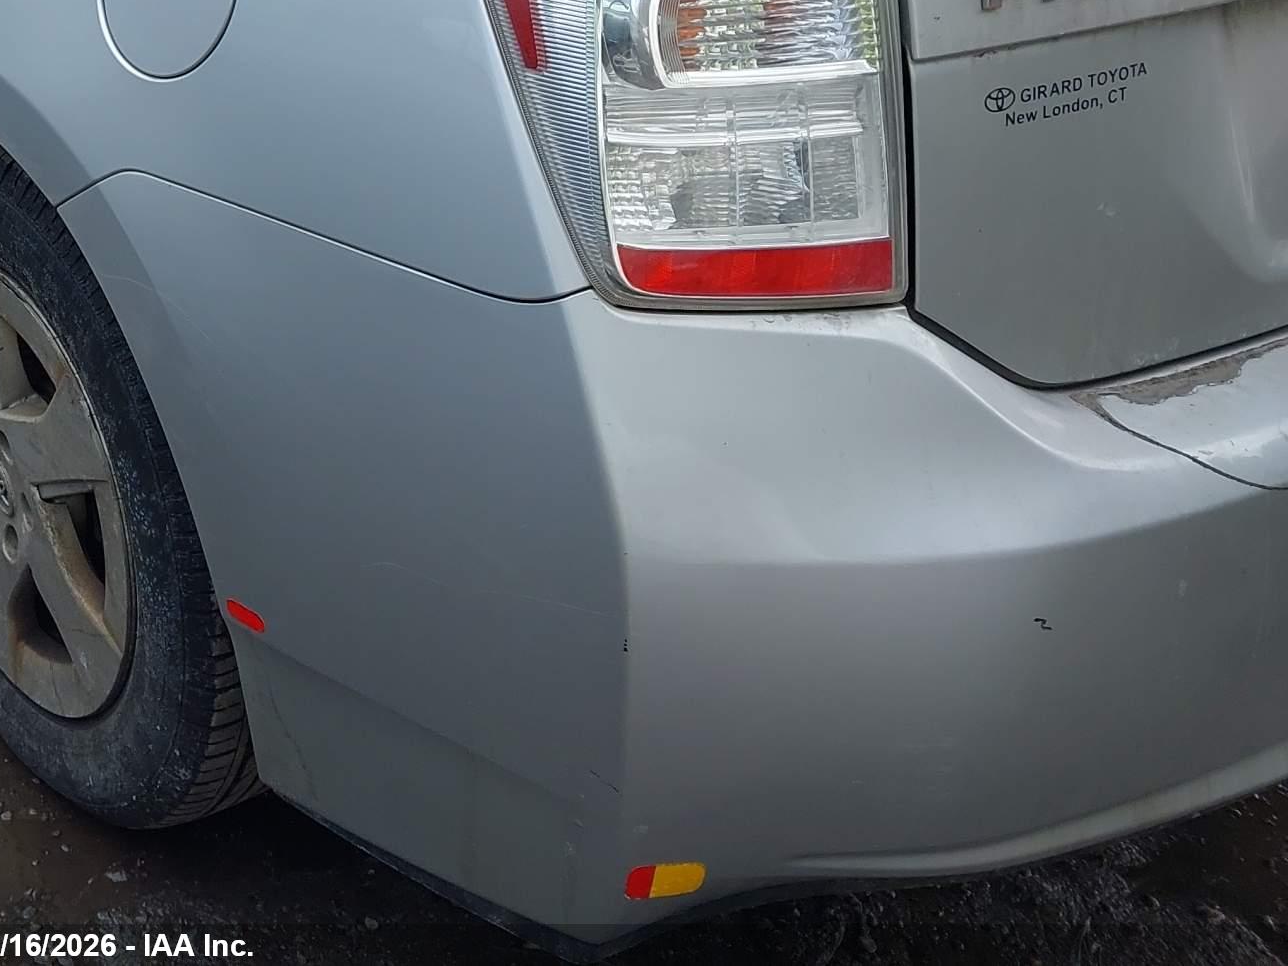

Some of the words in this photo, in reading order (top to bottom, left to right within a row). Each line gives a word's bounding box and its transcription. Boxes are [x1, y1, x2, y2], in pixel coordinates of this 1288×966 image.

[1020, 77, 1083, 103] GIRARD
[1087, 62, 1148, 88] TOYOTA
[1005, 110, 1038, 127] New
[1042, 97, 1103, 119] London,
[1108, 86, 1127, 104] CT
